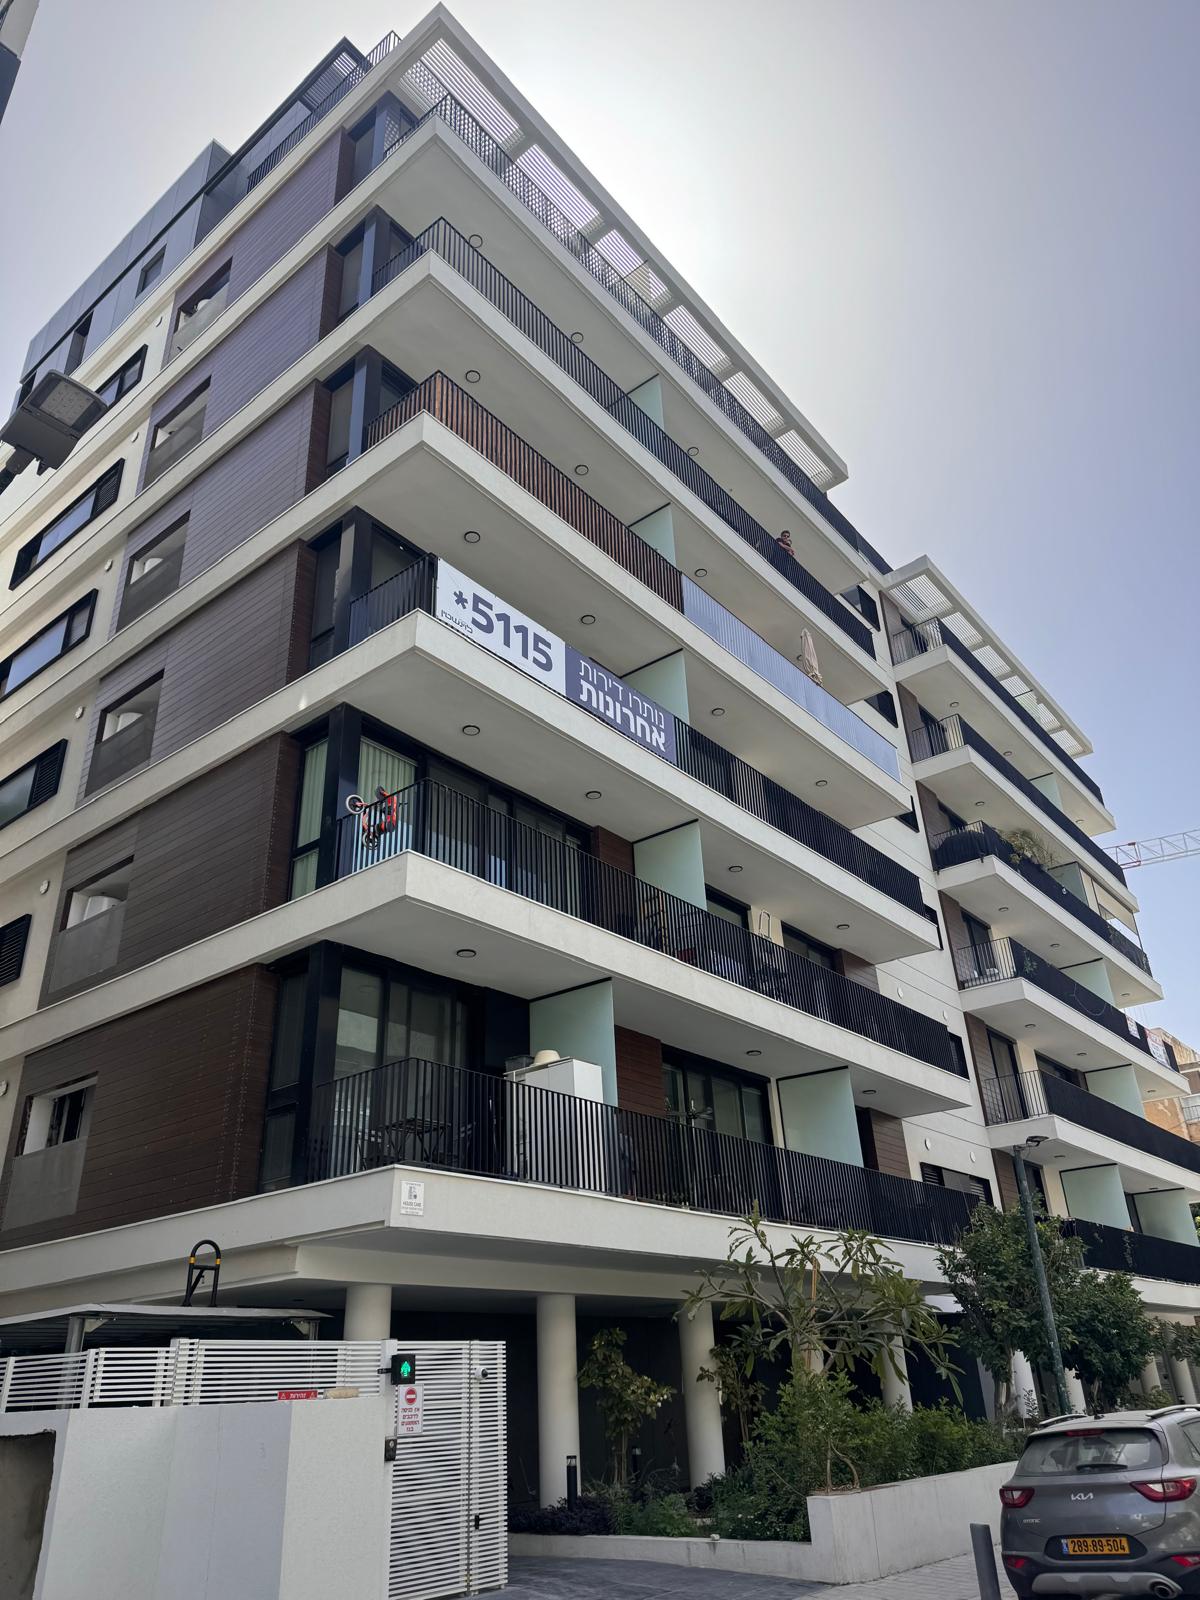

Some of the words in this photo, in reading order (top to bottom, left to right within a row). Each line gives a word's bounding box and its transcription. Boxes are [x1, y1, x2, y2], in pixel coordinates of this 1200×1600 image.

[579, 660, 623, 701] דירות
[579, 679, 666, 752] אחרונות
[628, 692, 665, 729] נותרו
